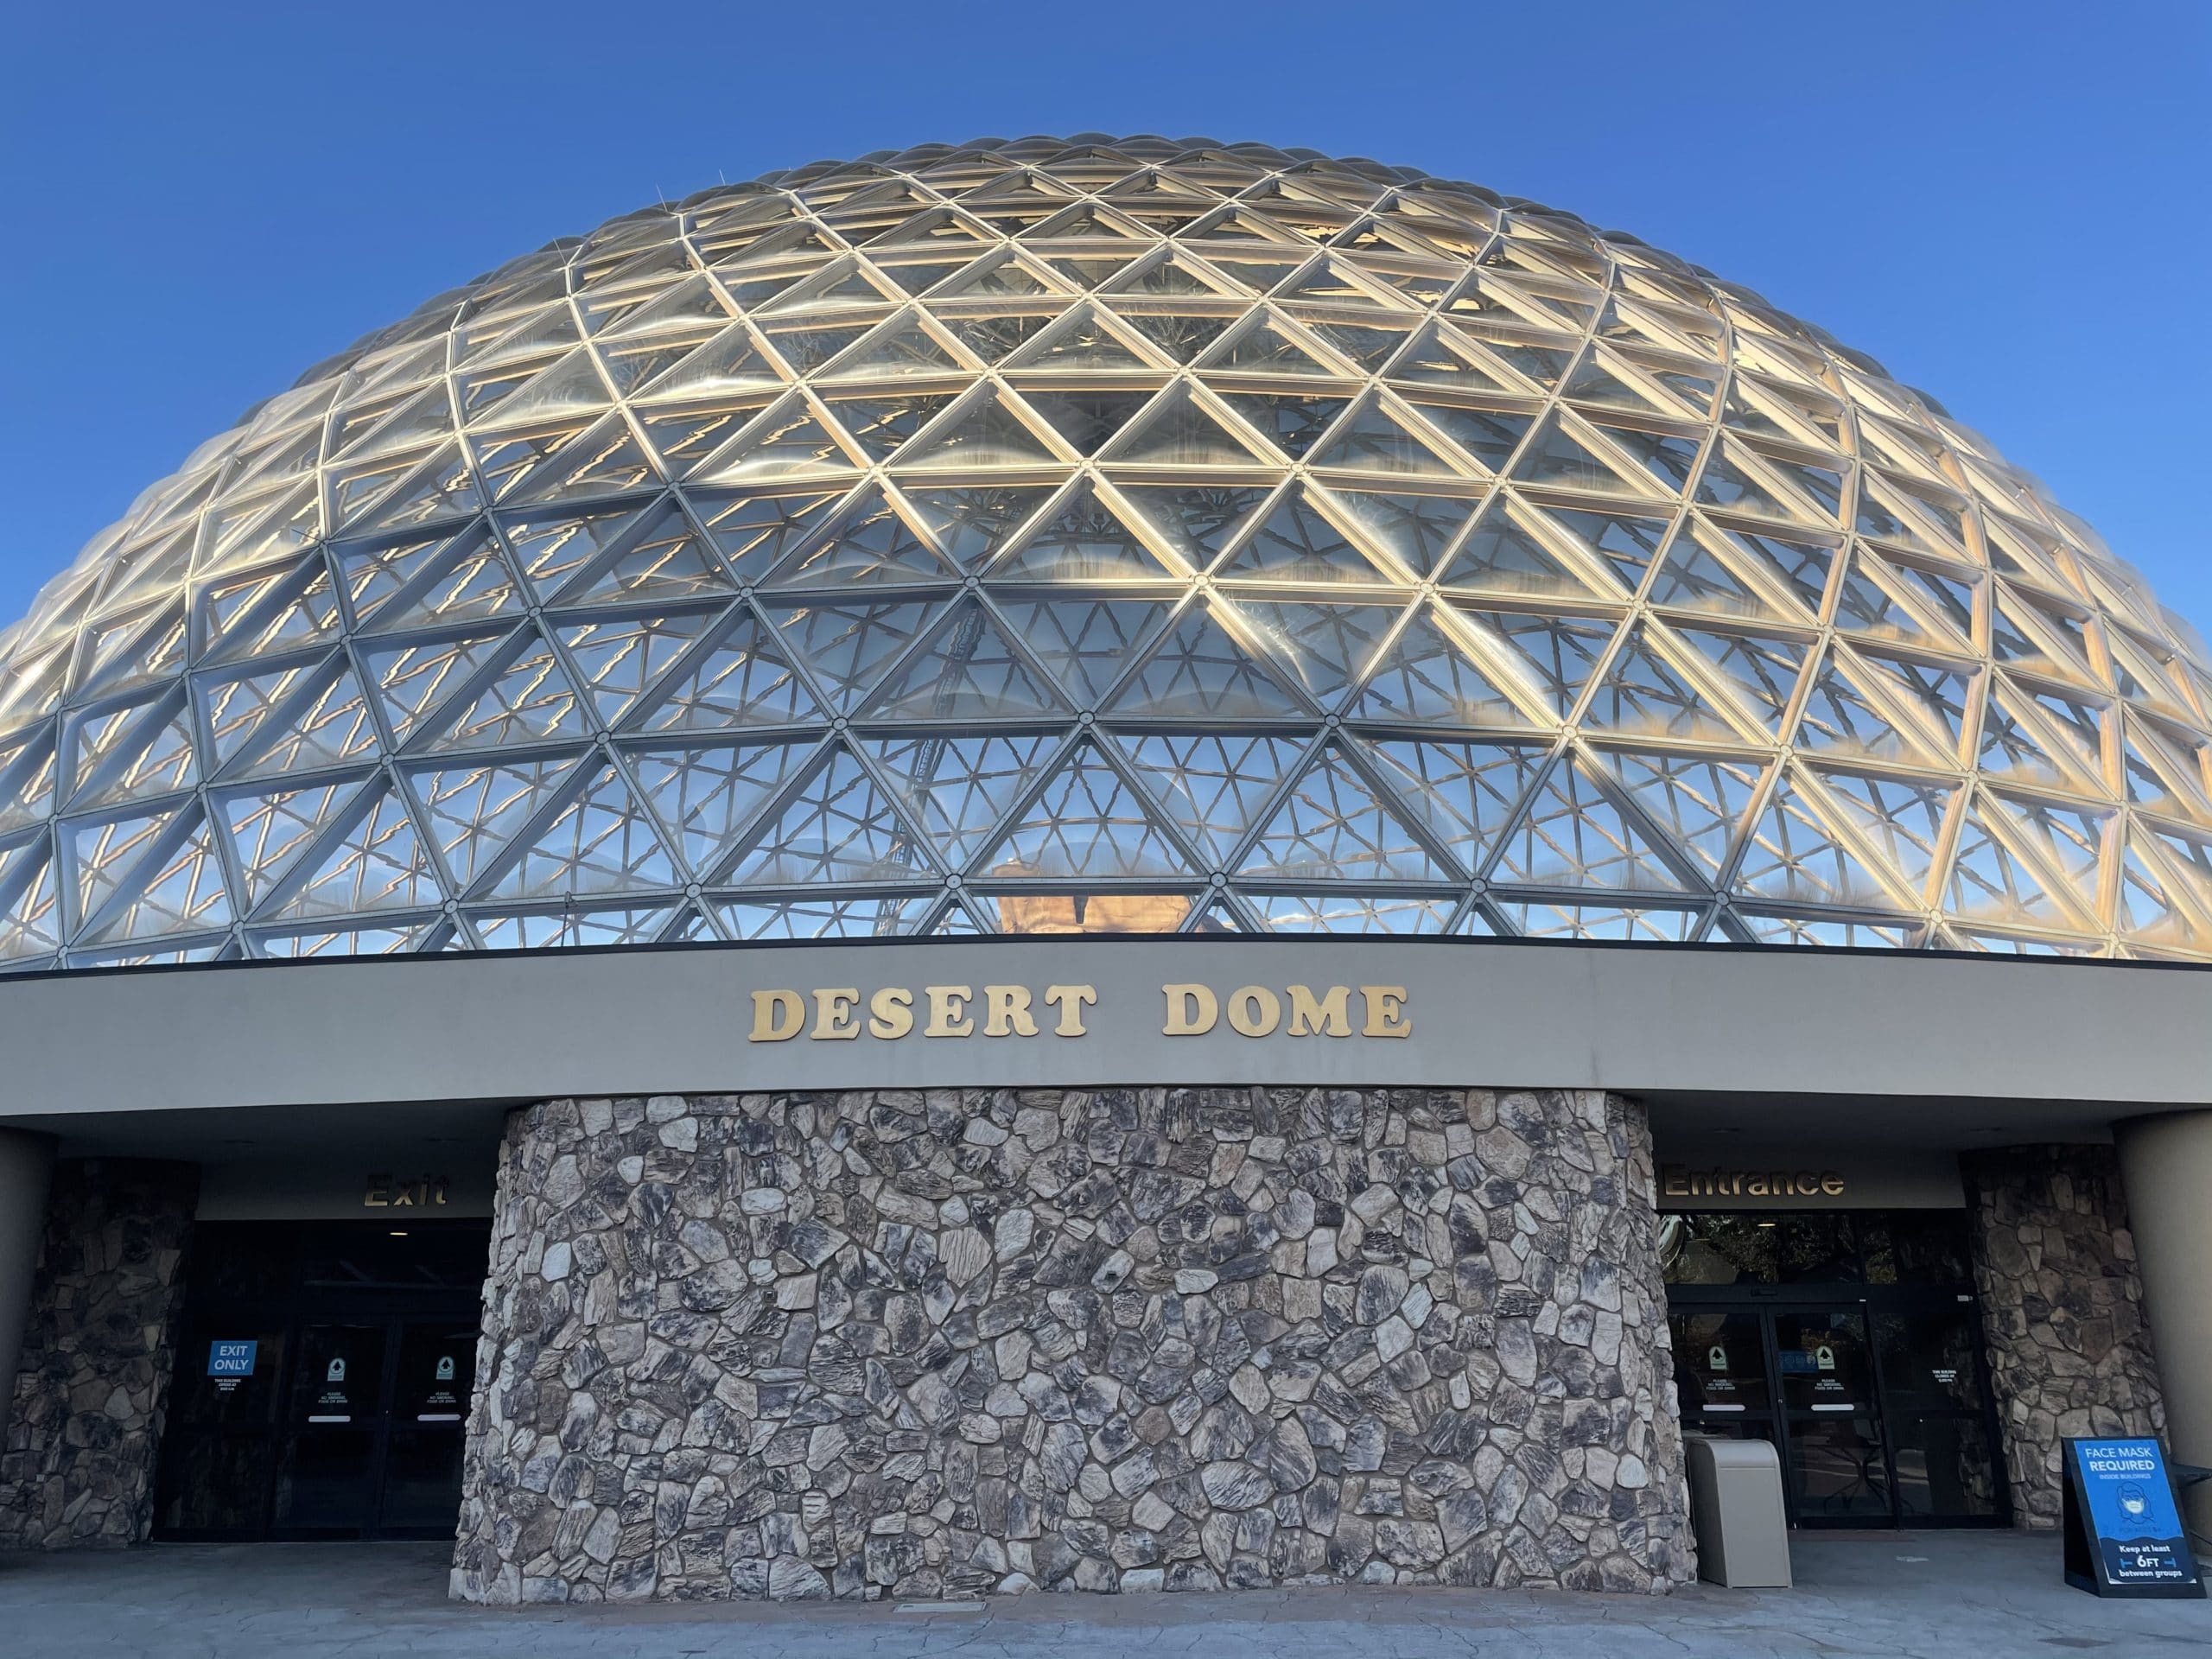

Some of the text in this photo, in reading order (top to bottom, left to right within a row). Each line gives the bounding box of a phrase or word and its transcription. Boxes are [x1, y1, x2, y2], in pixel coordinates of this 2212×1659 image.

[748, 983, 1412, 1042] DESERT DOME
[1663, 1165, 1844, 1196] Entrance
[365, 1175, 448, 1206] Exit
[219, 1345, 248, 1357] EXIT
[214, 1359, 249, 1370] ONLY
[2085, 1447, 2153, 1459] FACE MASK
[2089, 1460, 2155, 1471] REQUIRED
[2119, 1545, 2140, 1554] Keep
[2137, 1555, 2159, 1567] 6FT
